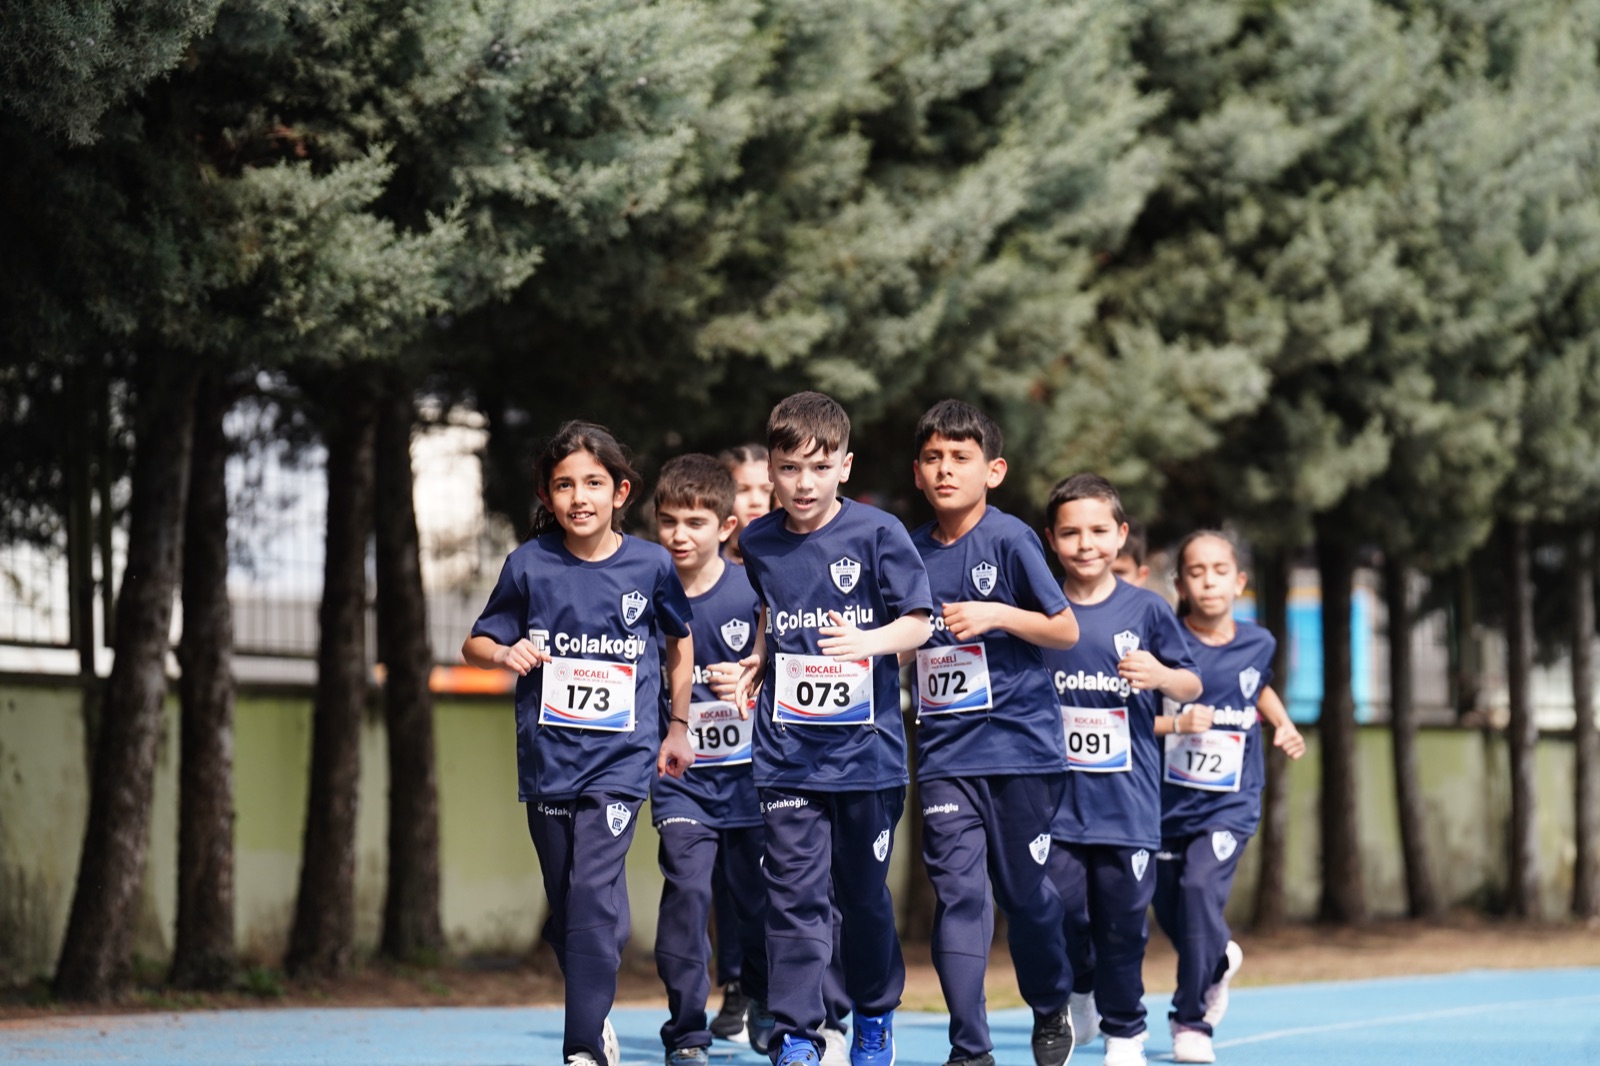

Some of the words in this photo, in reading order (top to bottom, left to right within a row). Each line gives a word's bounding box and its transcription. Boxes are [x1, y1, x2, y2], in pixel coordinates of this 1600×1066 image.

[805, 664, 842, 674] KOCAELİ
[930, 654, 957, 665] KOCAELİ
[573, 668, 609, 679] KOCAELİ
[928, 670, 968, 697] 072
[567, 684, 610, 712] 173
[796, 681, 850, 707] 073
[700, 709, 732, 719] KOCAELİ
[695, 725, 740, 749] 190
[1069, 731, 1110, 754] 091
[1186, 750, 1222, 773] 172
